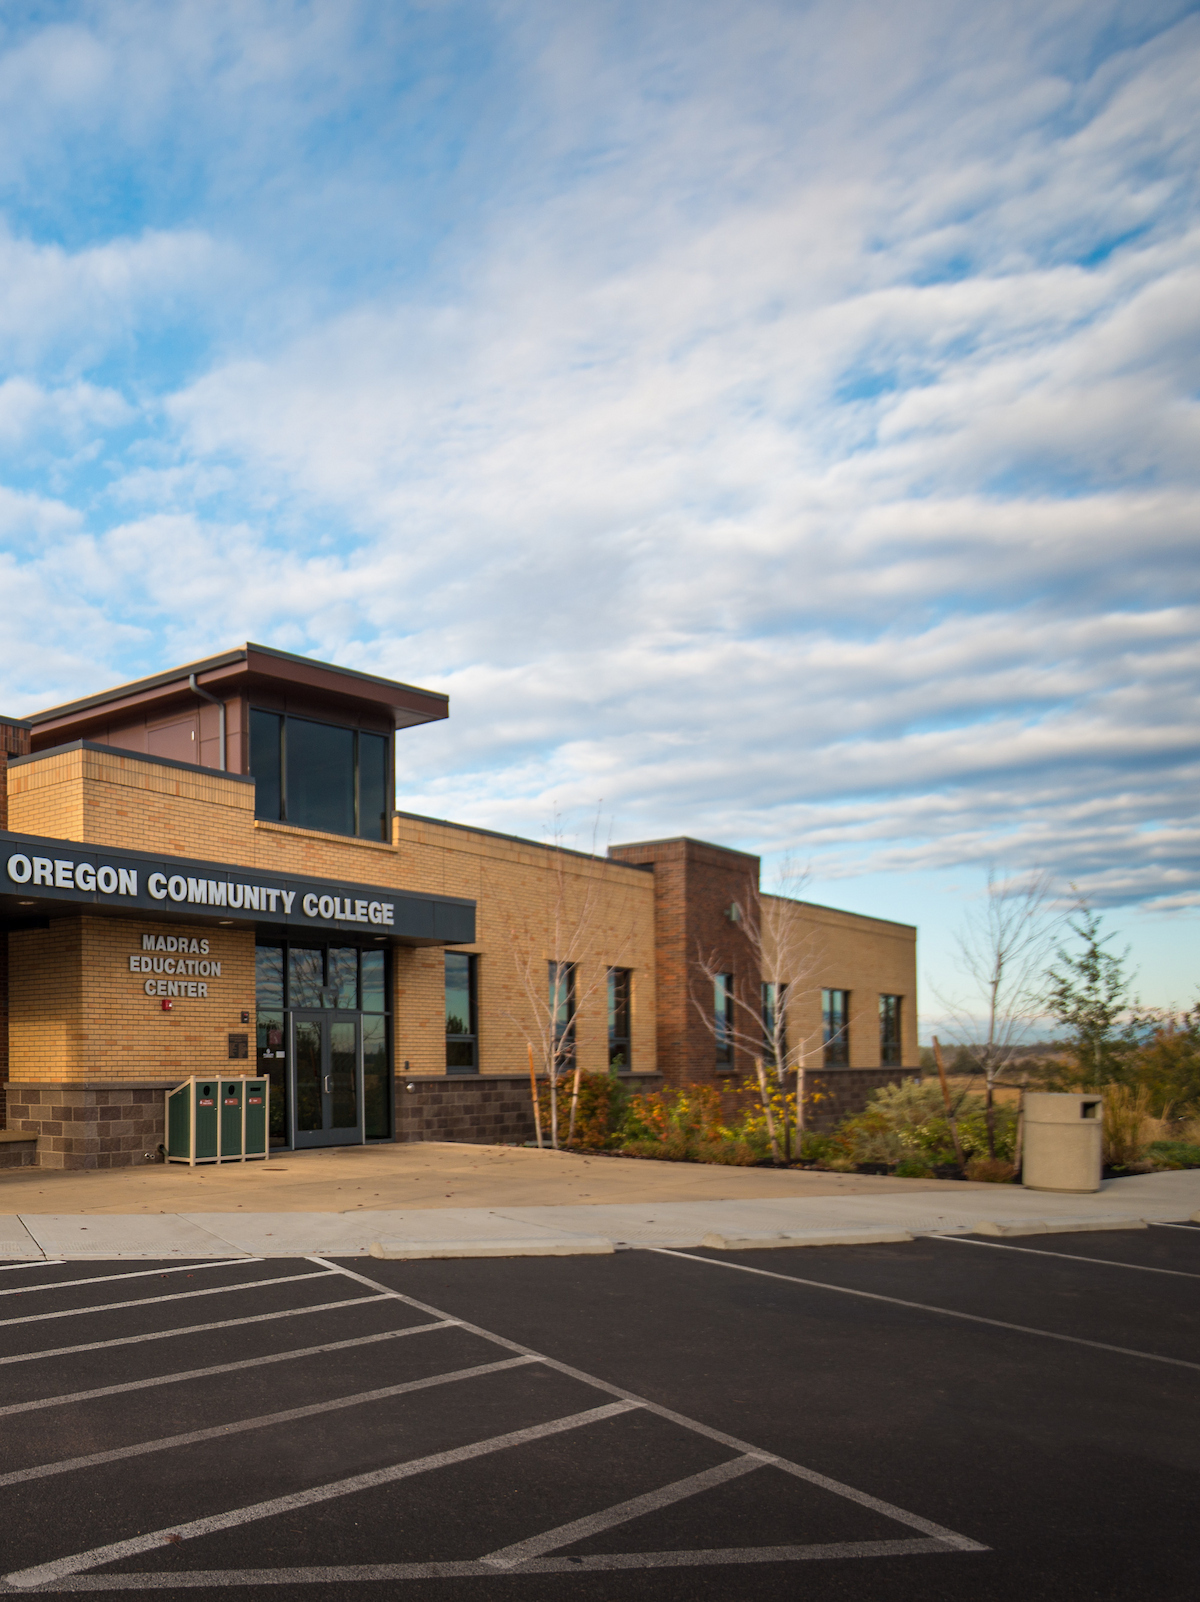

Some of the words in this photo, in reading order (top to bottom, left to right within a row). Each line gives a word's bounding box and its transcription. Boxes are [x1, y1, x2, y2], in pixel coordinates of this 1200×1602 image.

[7, 853, 138, 896] OREGON
[147, 872, 296, 914] COMMUNITY
[302, 892, 395, 925] COLLEGE
[142, 934, 210, 955] MADRAS
[129, 955, 221, 977] EDUCATION
[144, 979, 208, 998] CENTER
